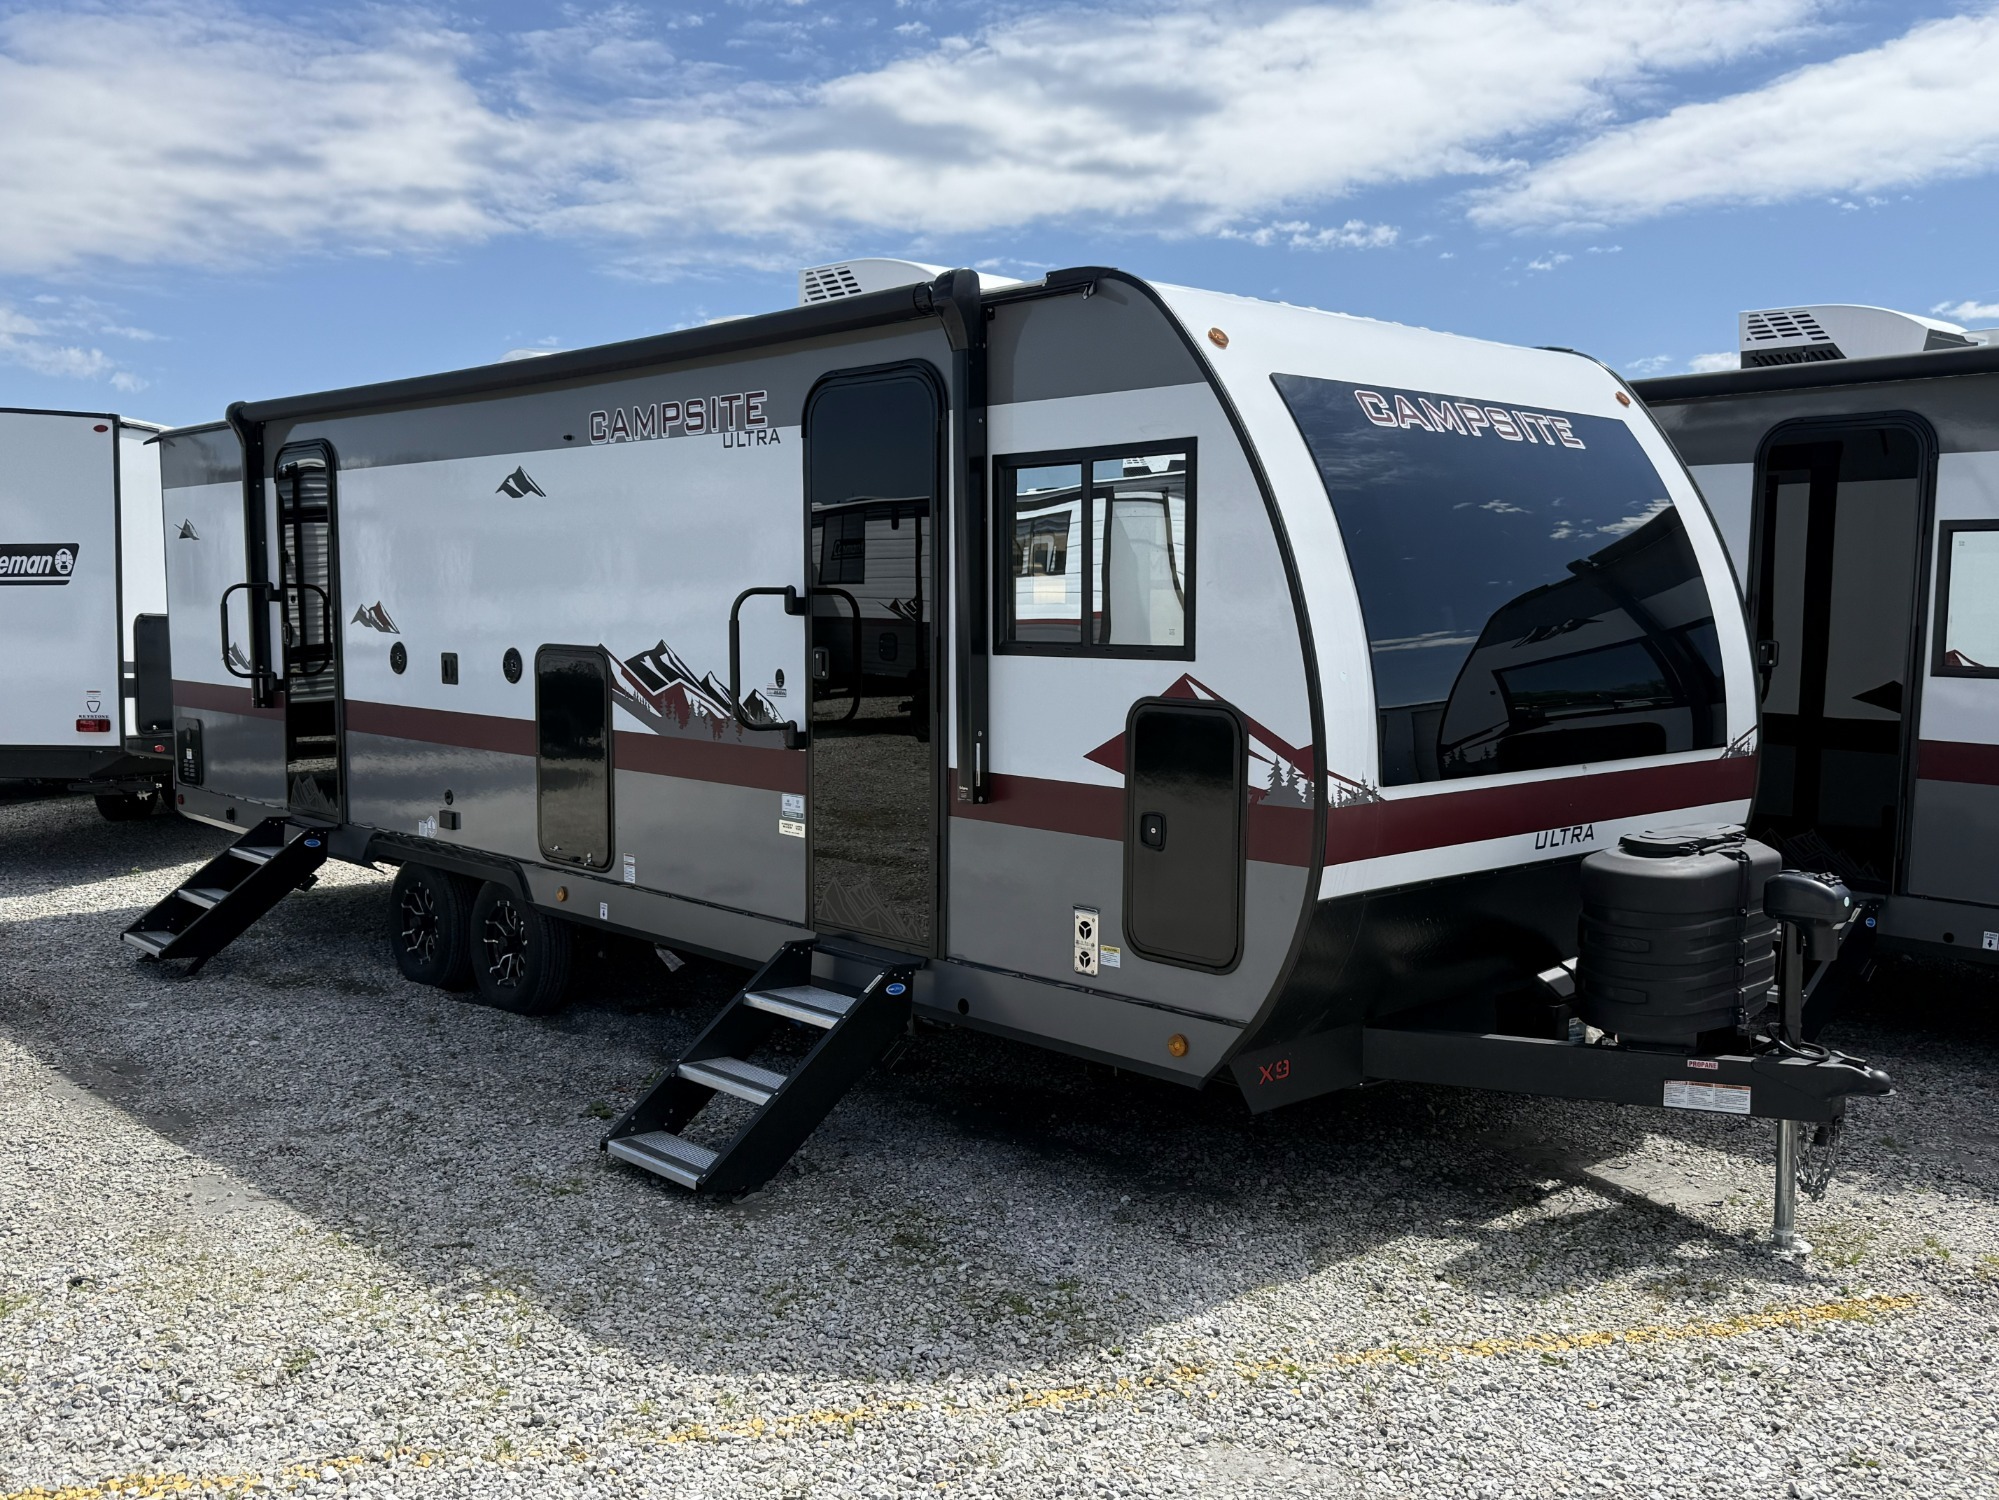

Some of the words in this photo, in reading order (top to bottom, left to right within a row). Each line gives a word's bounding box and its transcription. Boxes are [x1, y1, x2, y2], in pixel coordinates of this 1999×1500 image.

[589, 390, 768, 445] CAMPSITE
[1354, 390, 1586, 450] CAMPSITE
[723, 428, 781, 448] ULTRA
[1535, 824, 1594, 850] ULTRA
[1688, 1060, 1717, 1069] PROPANE
